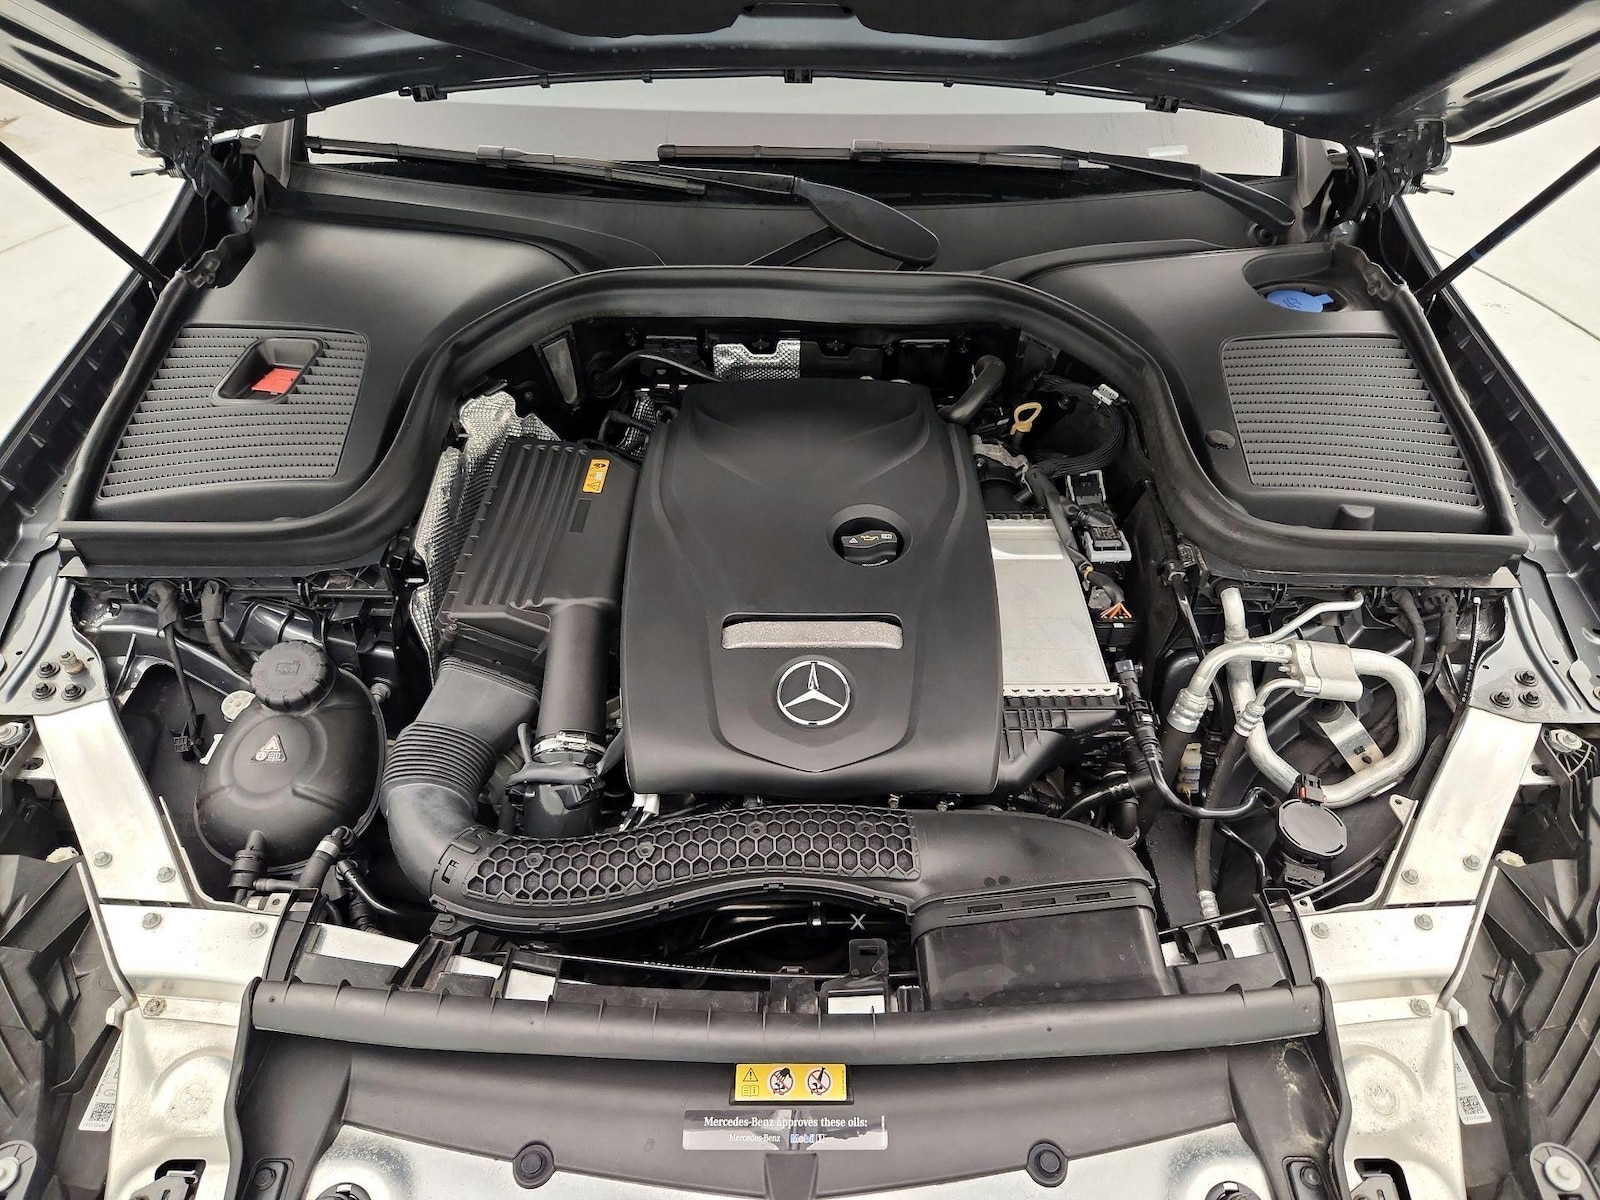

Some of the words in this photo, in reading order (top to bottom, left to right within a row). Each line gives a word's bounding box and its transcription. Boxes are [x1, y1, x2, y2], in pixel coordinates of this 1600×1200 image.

[703, 1116, 775, 1127] Mercedes-Benz
[776, 1117, 818, 1130] approves
[820, 1116, 847, 1127] these
[847, 1116, 868, 1127] oils:
[729, 1133, 781, 1143] Mercedes-Benz
